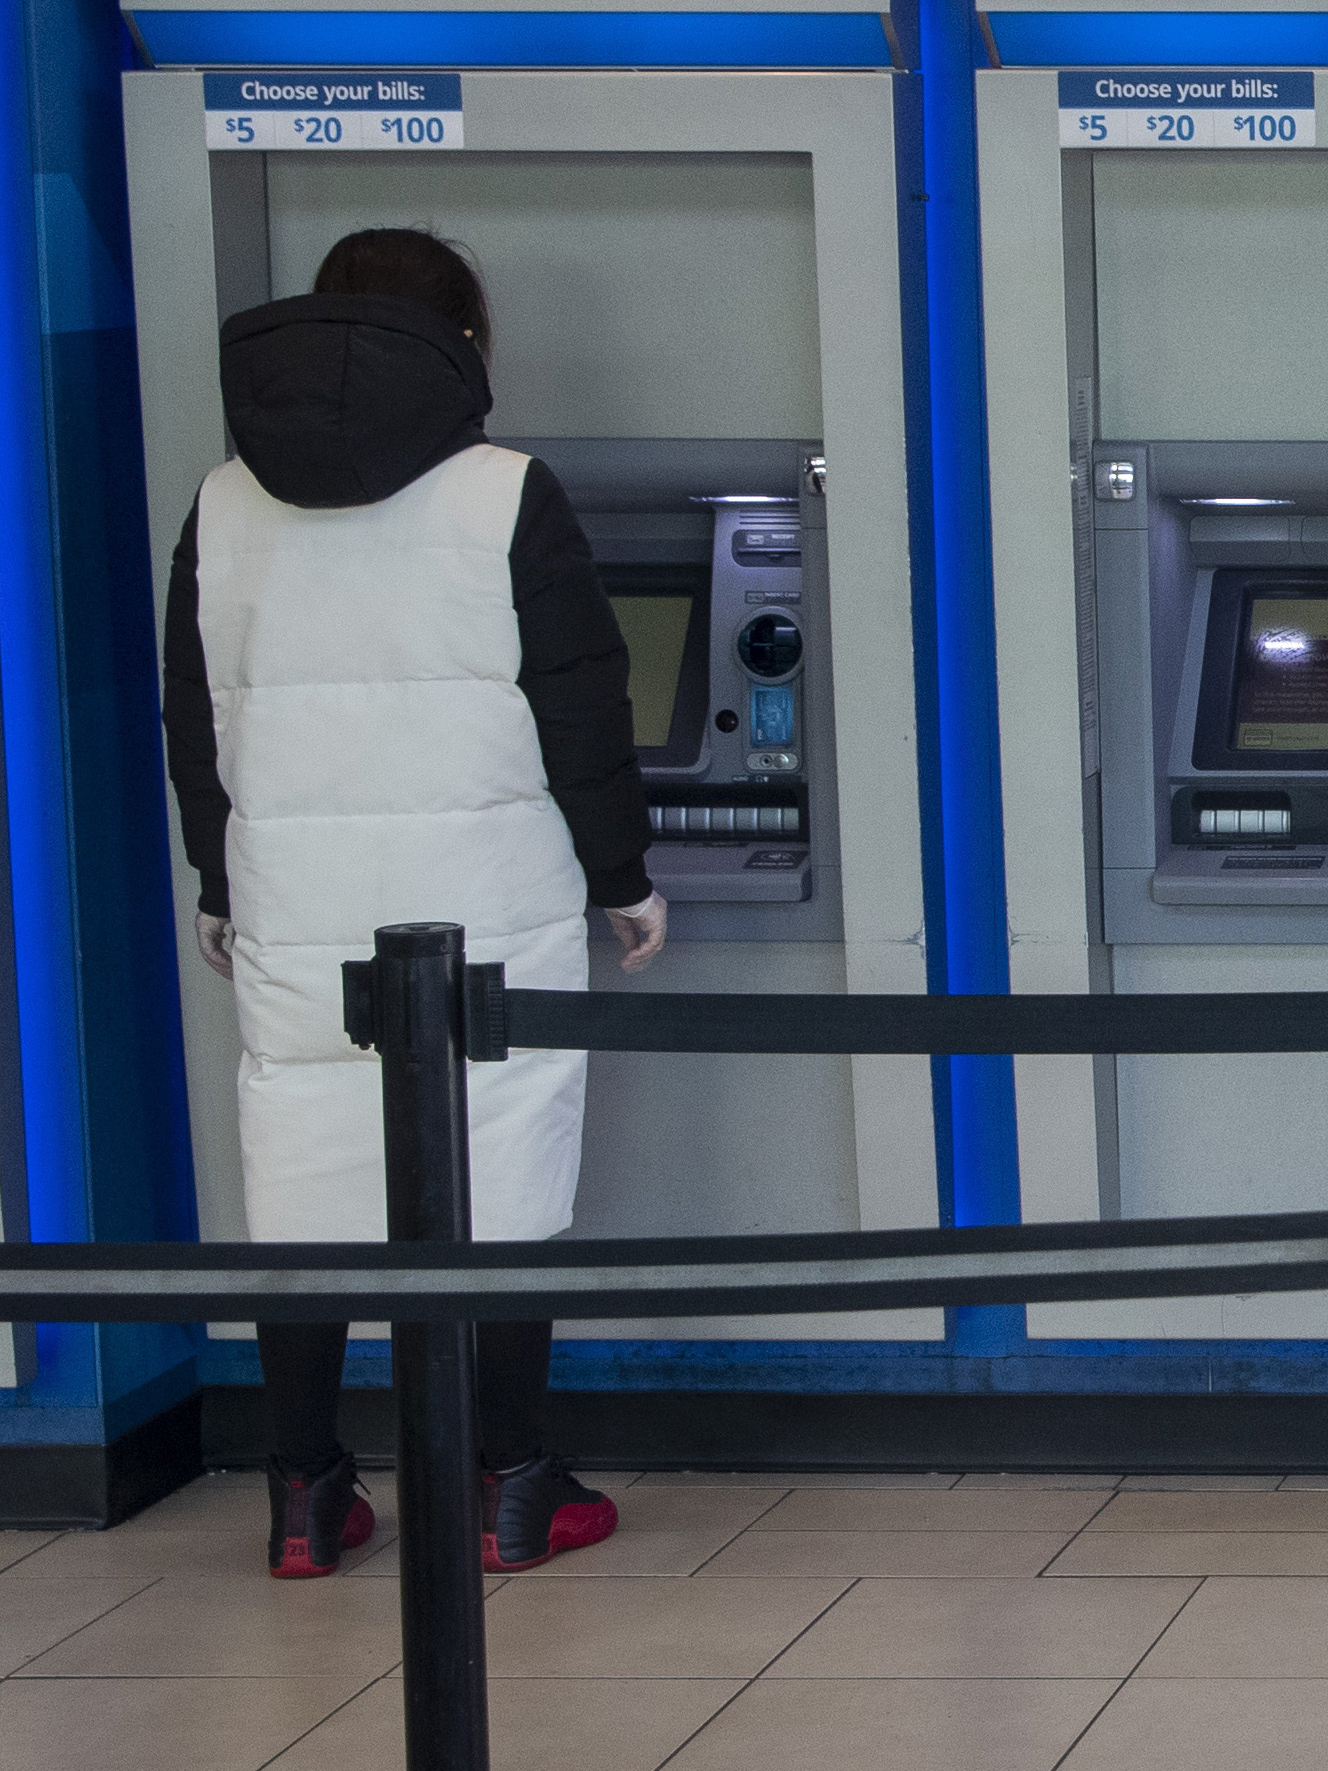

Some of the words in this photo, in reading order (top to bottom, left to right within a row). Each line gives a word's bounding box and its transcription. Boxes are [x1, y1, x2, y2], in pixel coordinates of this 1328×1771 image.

[241, 81, 318, 100] Choose
[322, 84, 373, 105] your
[377, 81, 425, 101] bills:
[1095, 79, 1172, 98] Choose
[1176, 82, 1226, 103] your
[1231, 79, 1279, 99] bills:
[225, 117, 255, 143] $5
[294, 117, 343, 143] $20
[381, 117, 444, 143] $100
[1079, 115, 1108, 141] $5
[1146, 115, 1195, 141] $20
[1234, 115, 1297, 141] $100
